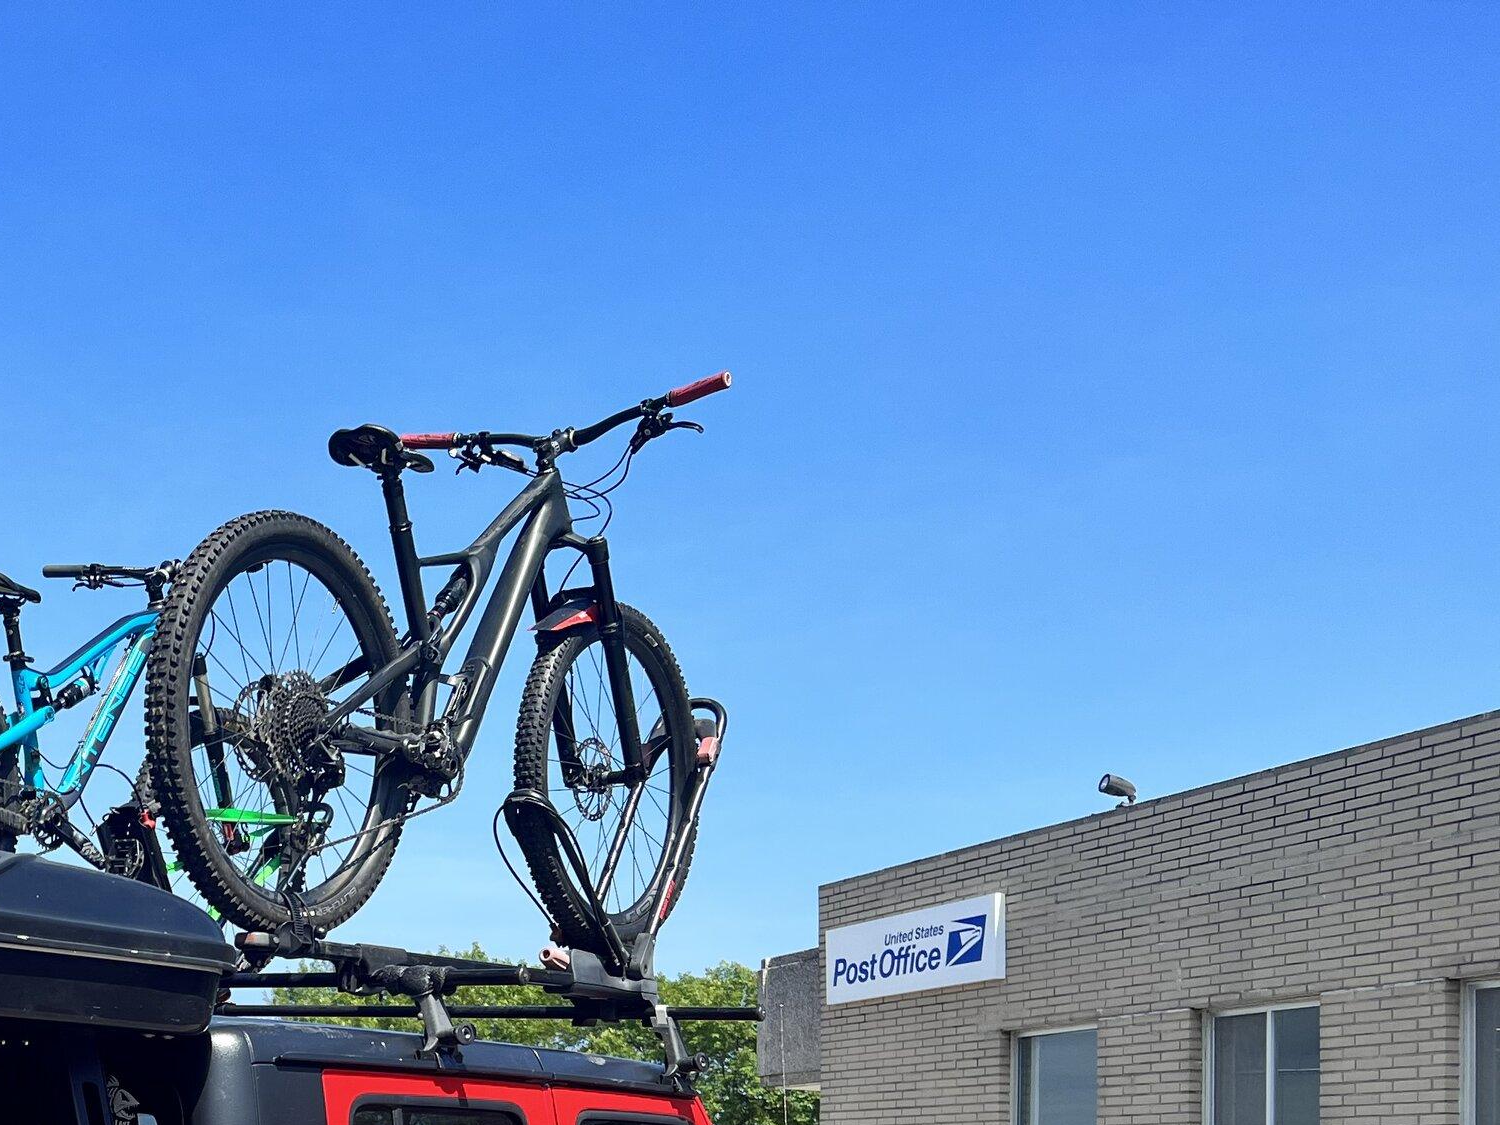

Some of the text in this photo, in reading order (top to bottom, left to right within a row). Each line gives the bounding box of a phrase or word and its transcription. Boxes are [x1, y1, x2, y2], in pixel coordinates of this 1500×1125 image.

[884, 924, 944, 946] United States
[832, 944, 942, 987] Post Office
